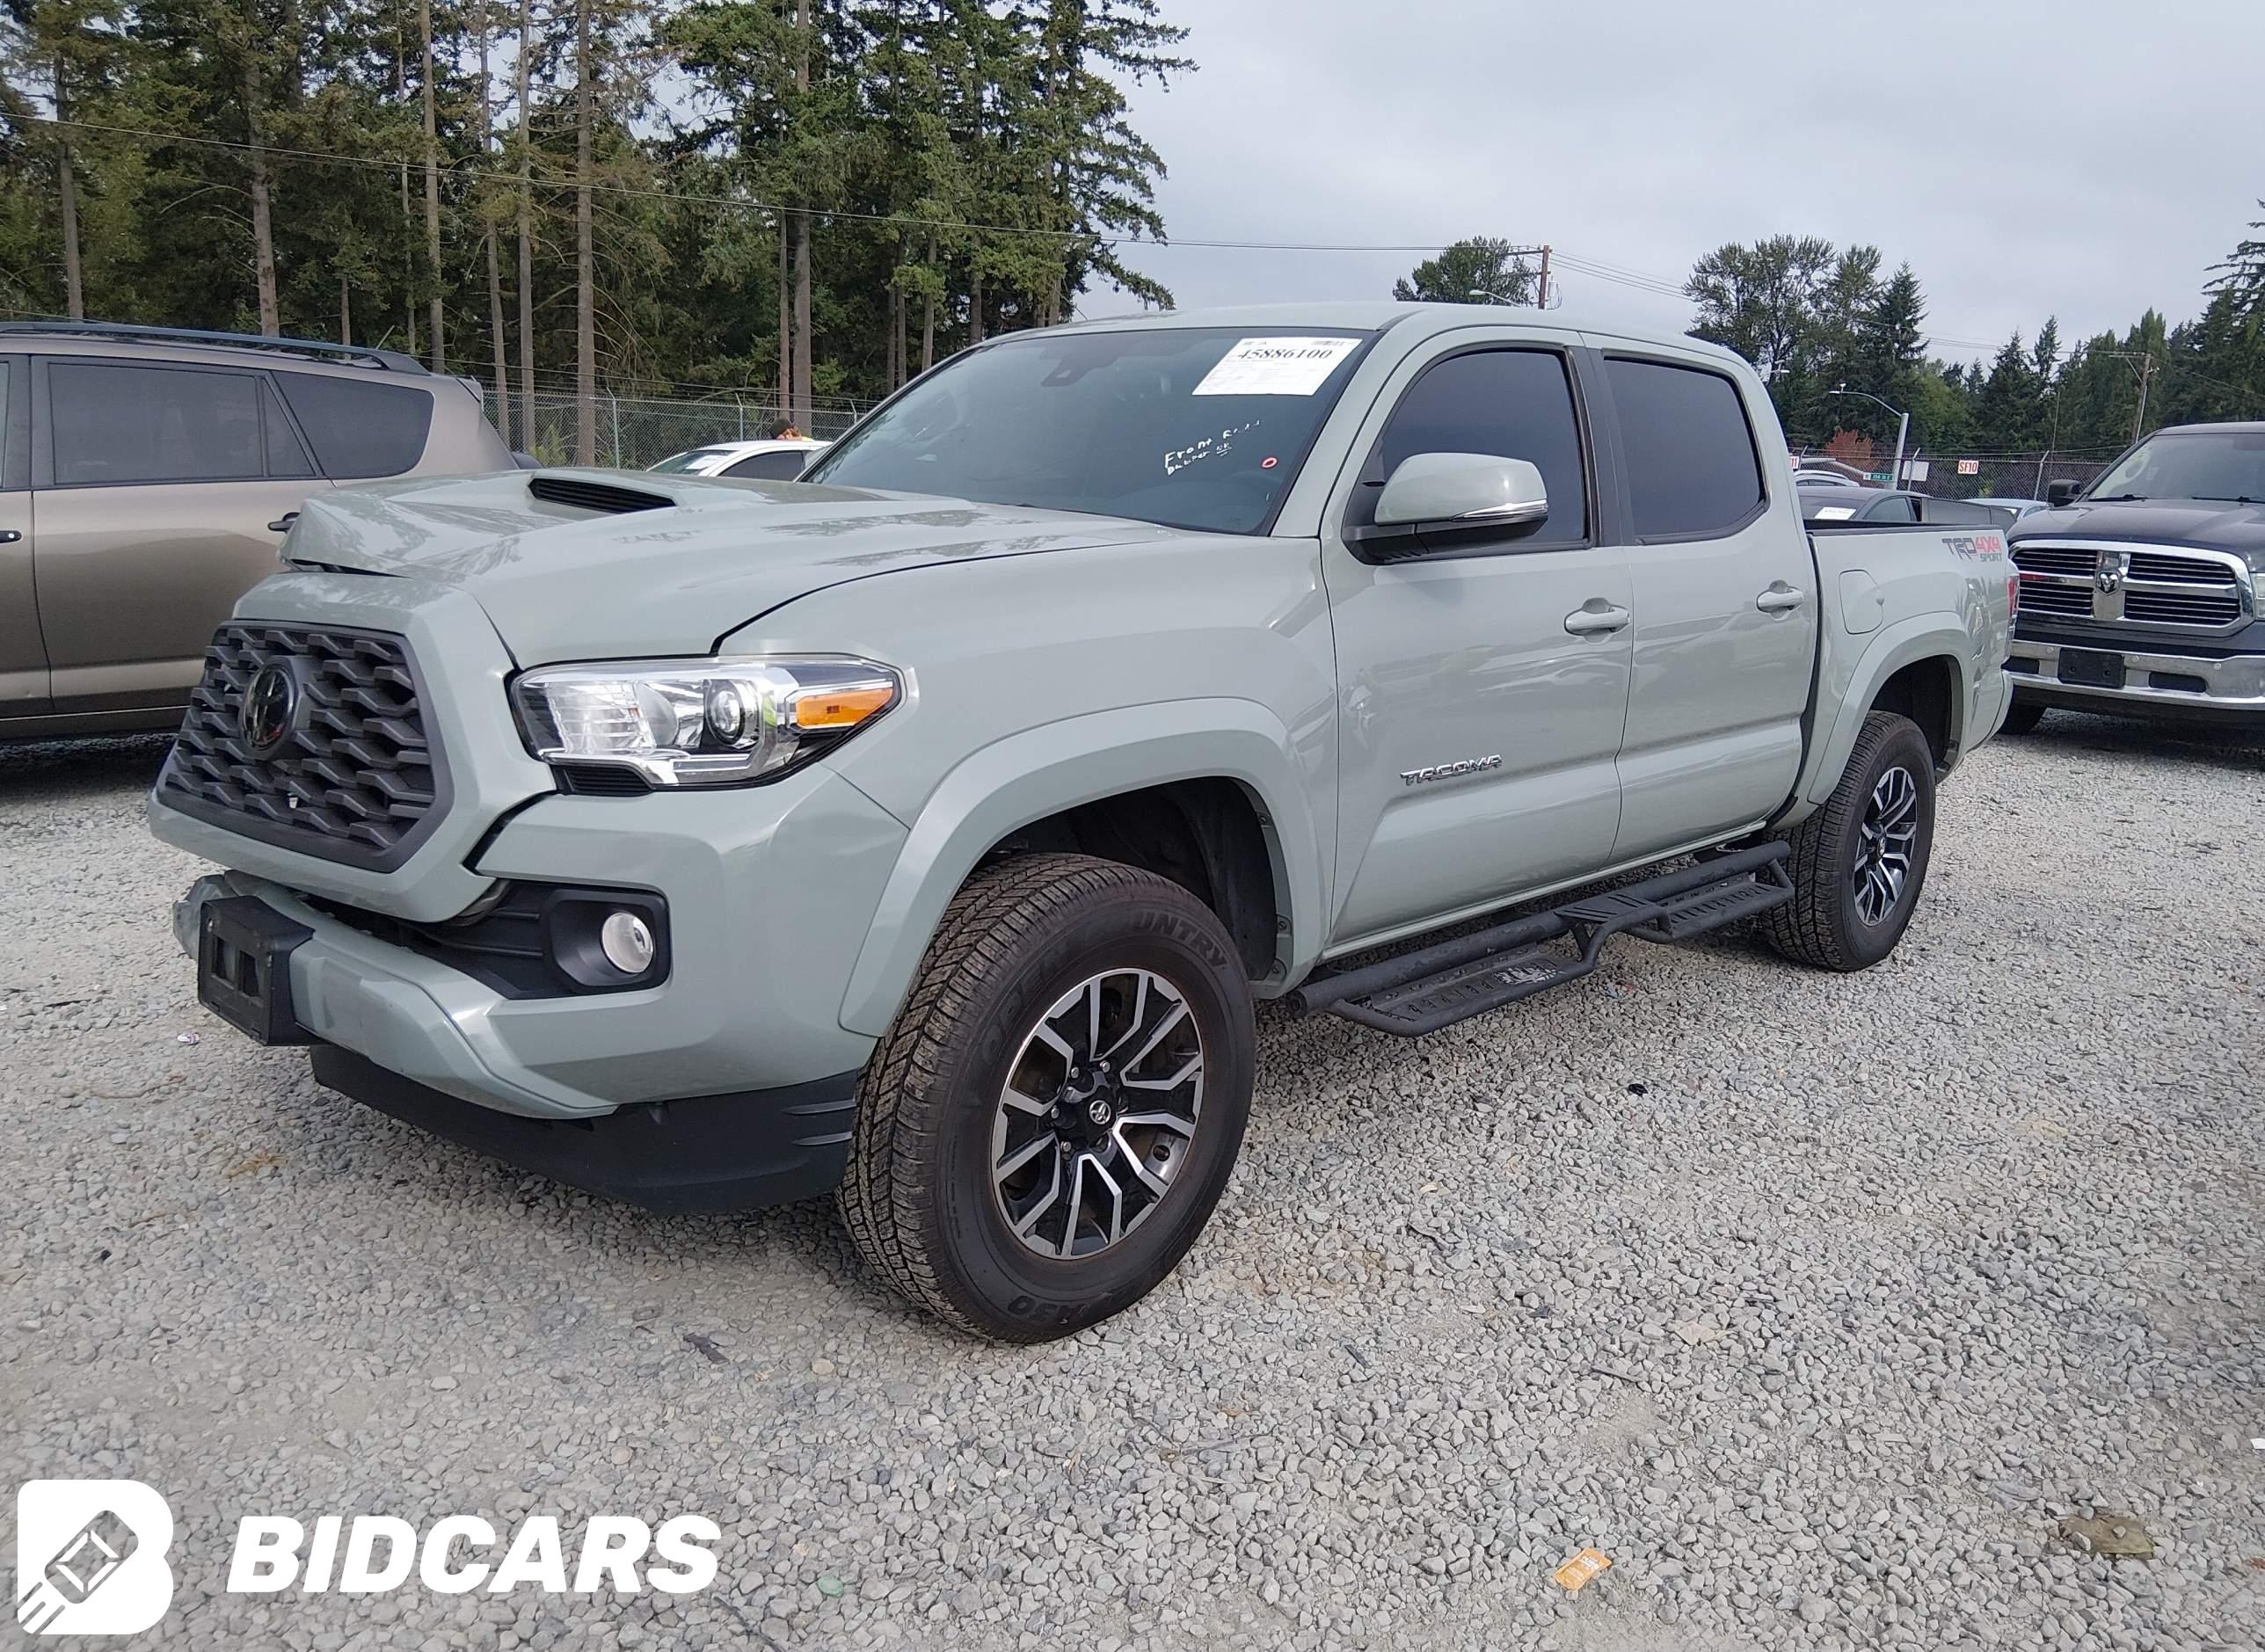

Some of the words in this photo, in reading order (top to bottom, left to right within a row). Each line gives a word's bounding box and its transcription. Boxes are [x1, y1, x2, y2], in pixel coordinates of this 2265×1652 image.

[1238, 349, 1333, 360] 45886100
[1164, 437, 1213, 469] Front
[1959, 461, 1977, 473] SF10
[1941, 537, 1977, 560] TRD
[1979, 553, 2003, 563] SPORT
[1400, 754, 1502, 786] TACOMA
[1135, 911, 1229, 967] UNTRY
